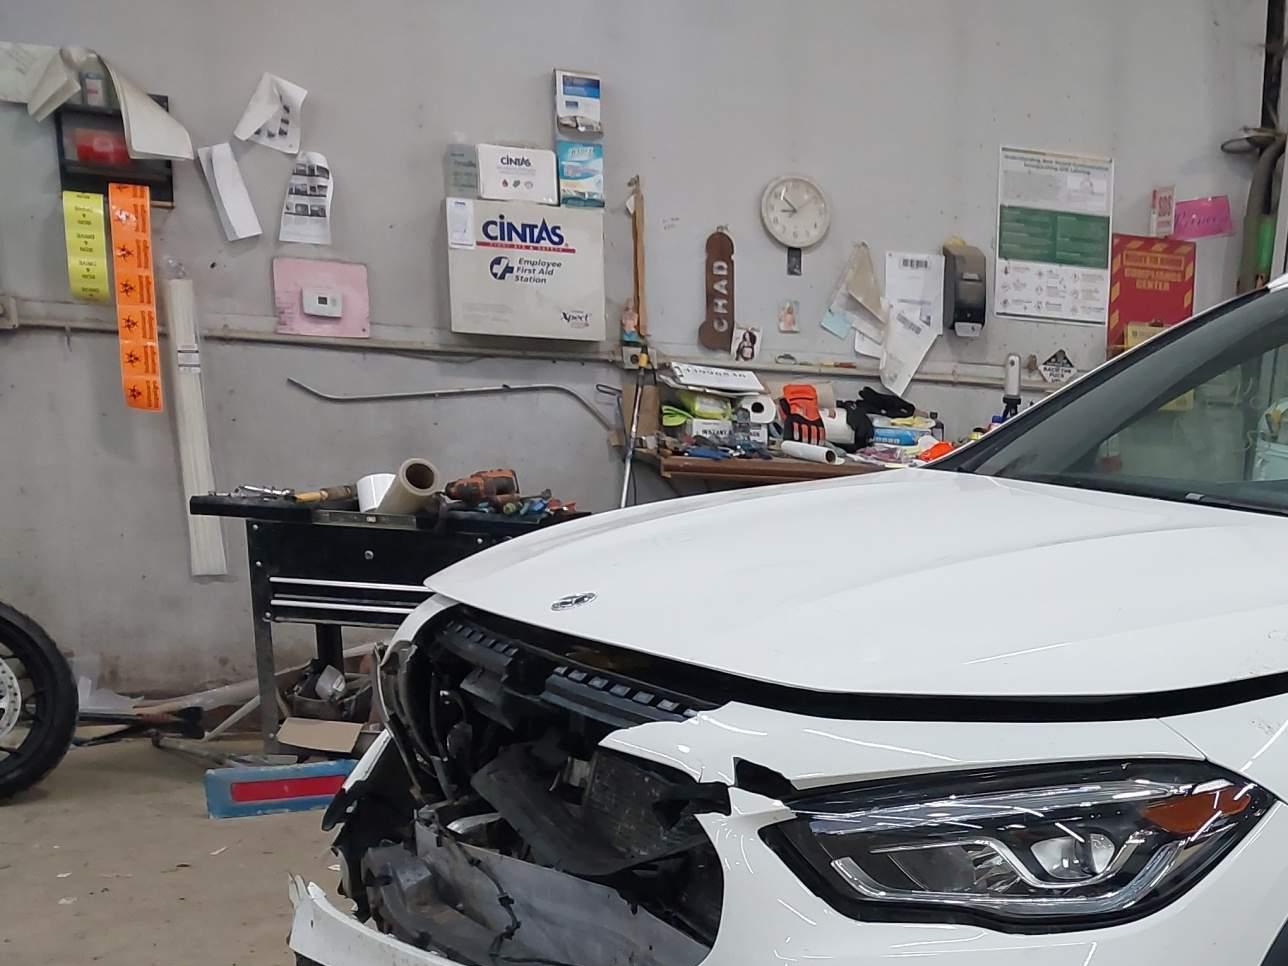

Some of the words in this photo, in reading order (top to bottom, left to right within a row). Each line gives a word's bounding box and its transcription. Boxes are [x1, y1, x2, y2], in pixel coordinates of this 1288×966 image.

[518, 257, 562, 269] Employee
[516, 267, 536, 275] First
[538, 267, 554, 276] Aid
[514, 275, 547, 284] Station
[713, 260, 729, 332] CHAD
